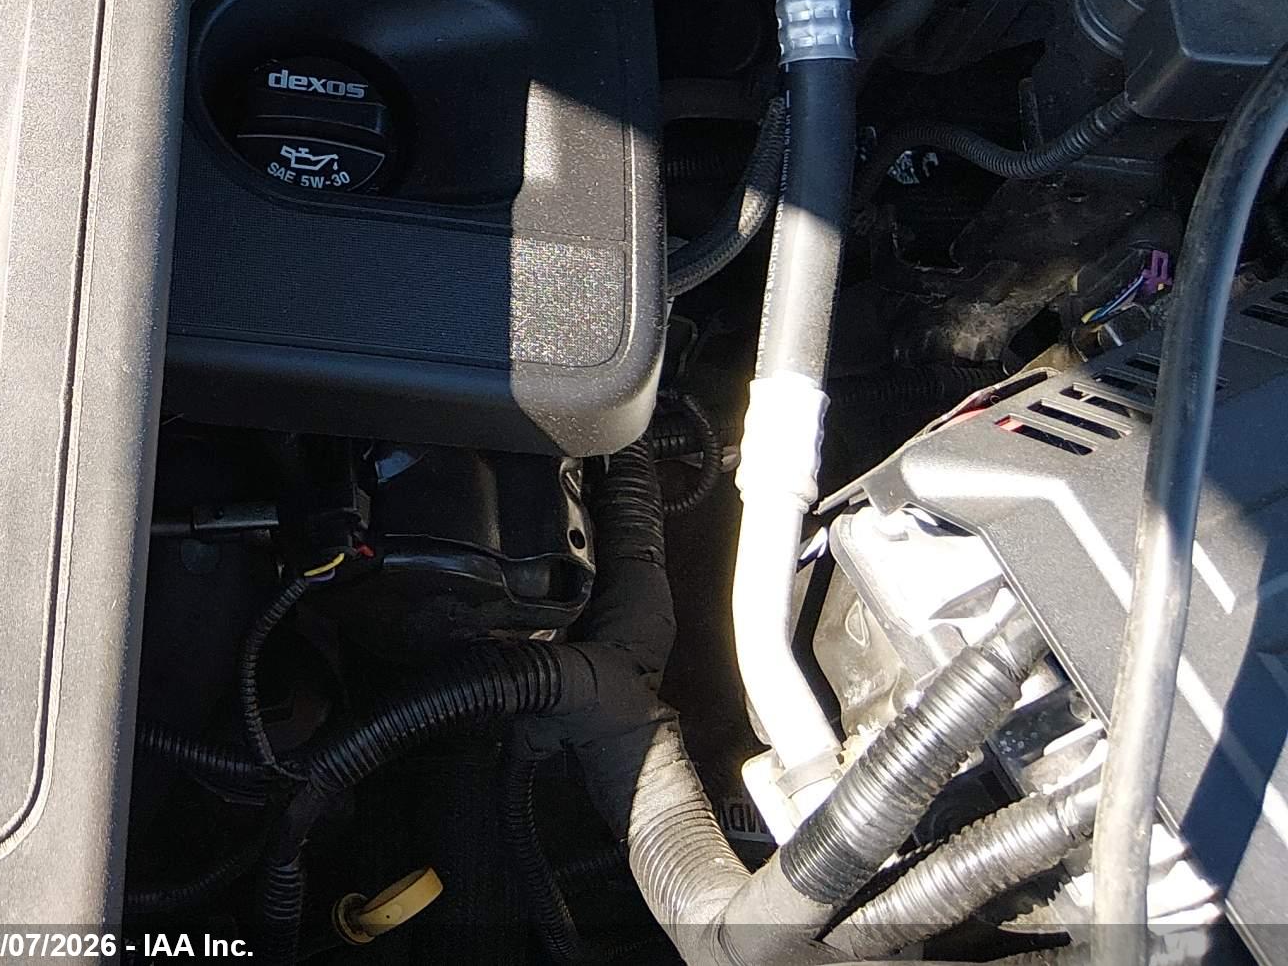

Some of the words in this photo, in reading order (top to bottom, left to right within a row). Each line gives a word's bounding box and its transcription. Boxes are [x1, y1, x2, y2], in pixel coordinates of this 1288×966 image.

[268, 69, 369, 99] dexos
[267, 161, 297, 183] SAE
[300, 170, 351, 189] 5W-30
